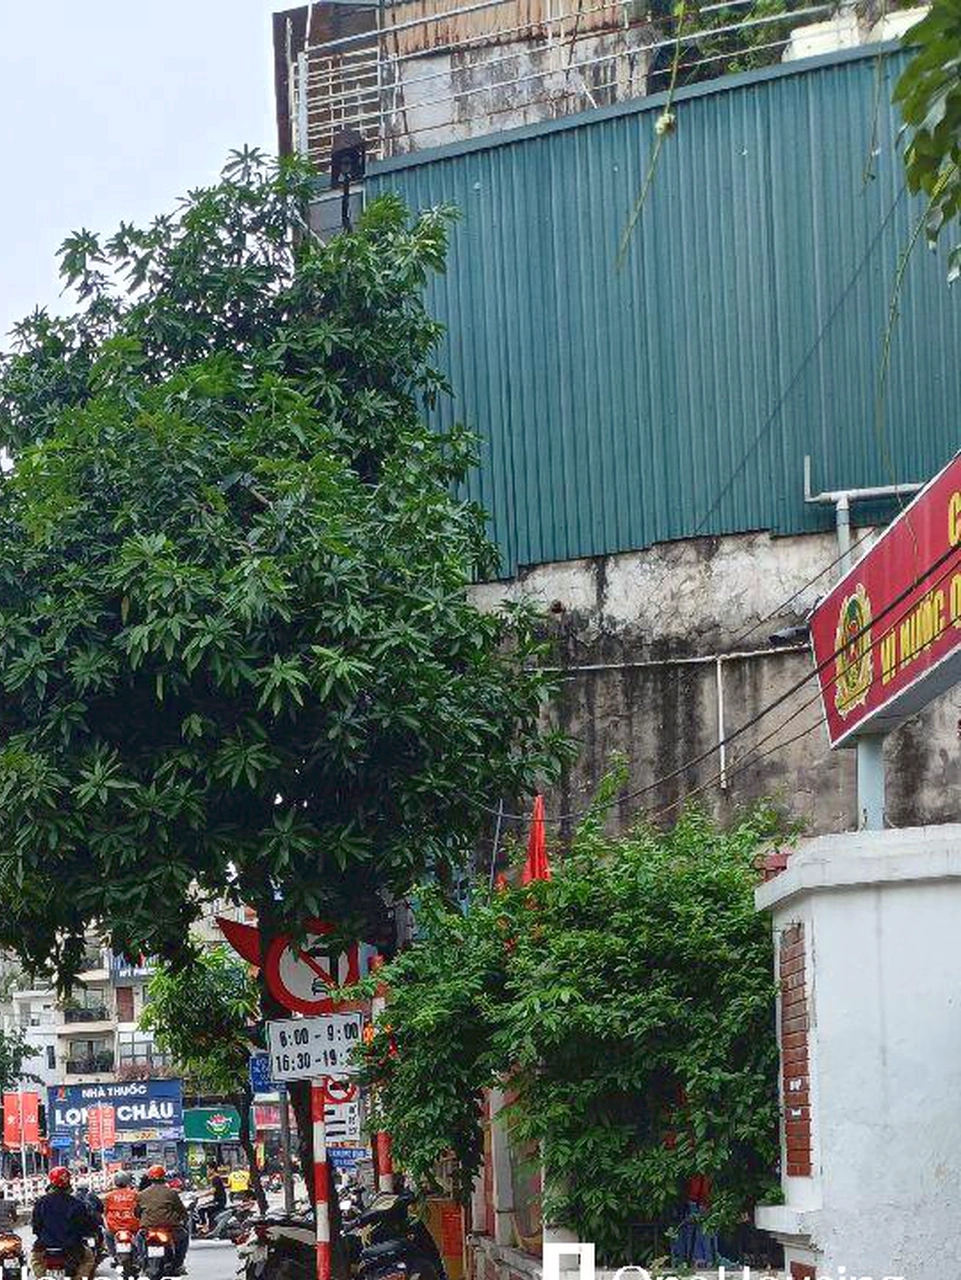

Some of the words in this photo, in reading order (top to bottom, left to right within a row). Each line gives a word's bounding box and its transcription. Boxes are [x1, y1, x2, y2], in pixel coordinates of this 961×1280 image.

[327, 1022, 358, 1041] 9:00
[276, 1052, 311, 1072] 16:30
[82, 1086, 105, 1099] NHÀ
[107, 1083, 147, 1097] THUỐC
[117, 1100, 174, 1121] CHÂU
